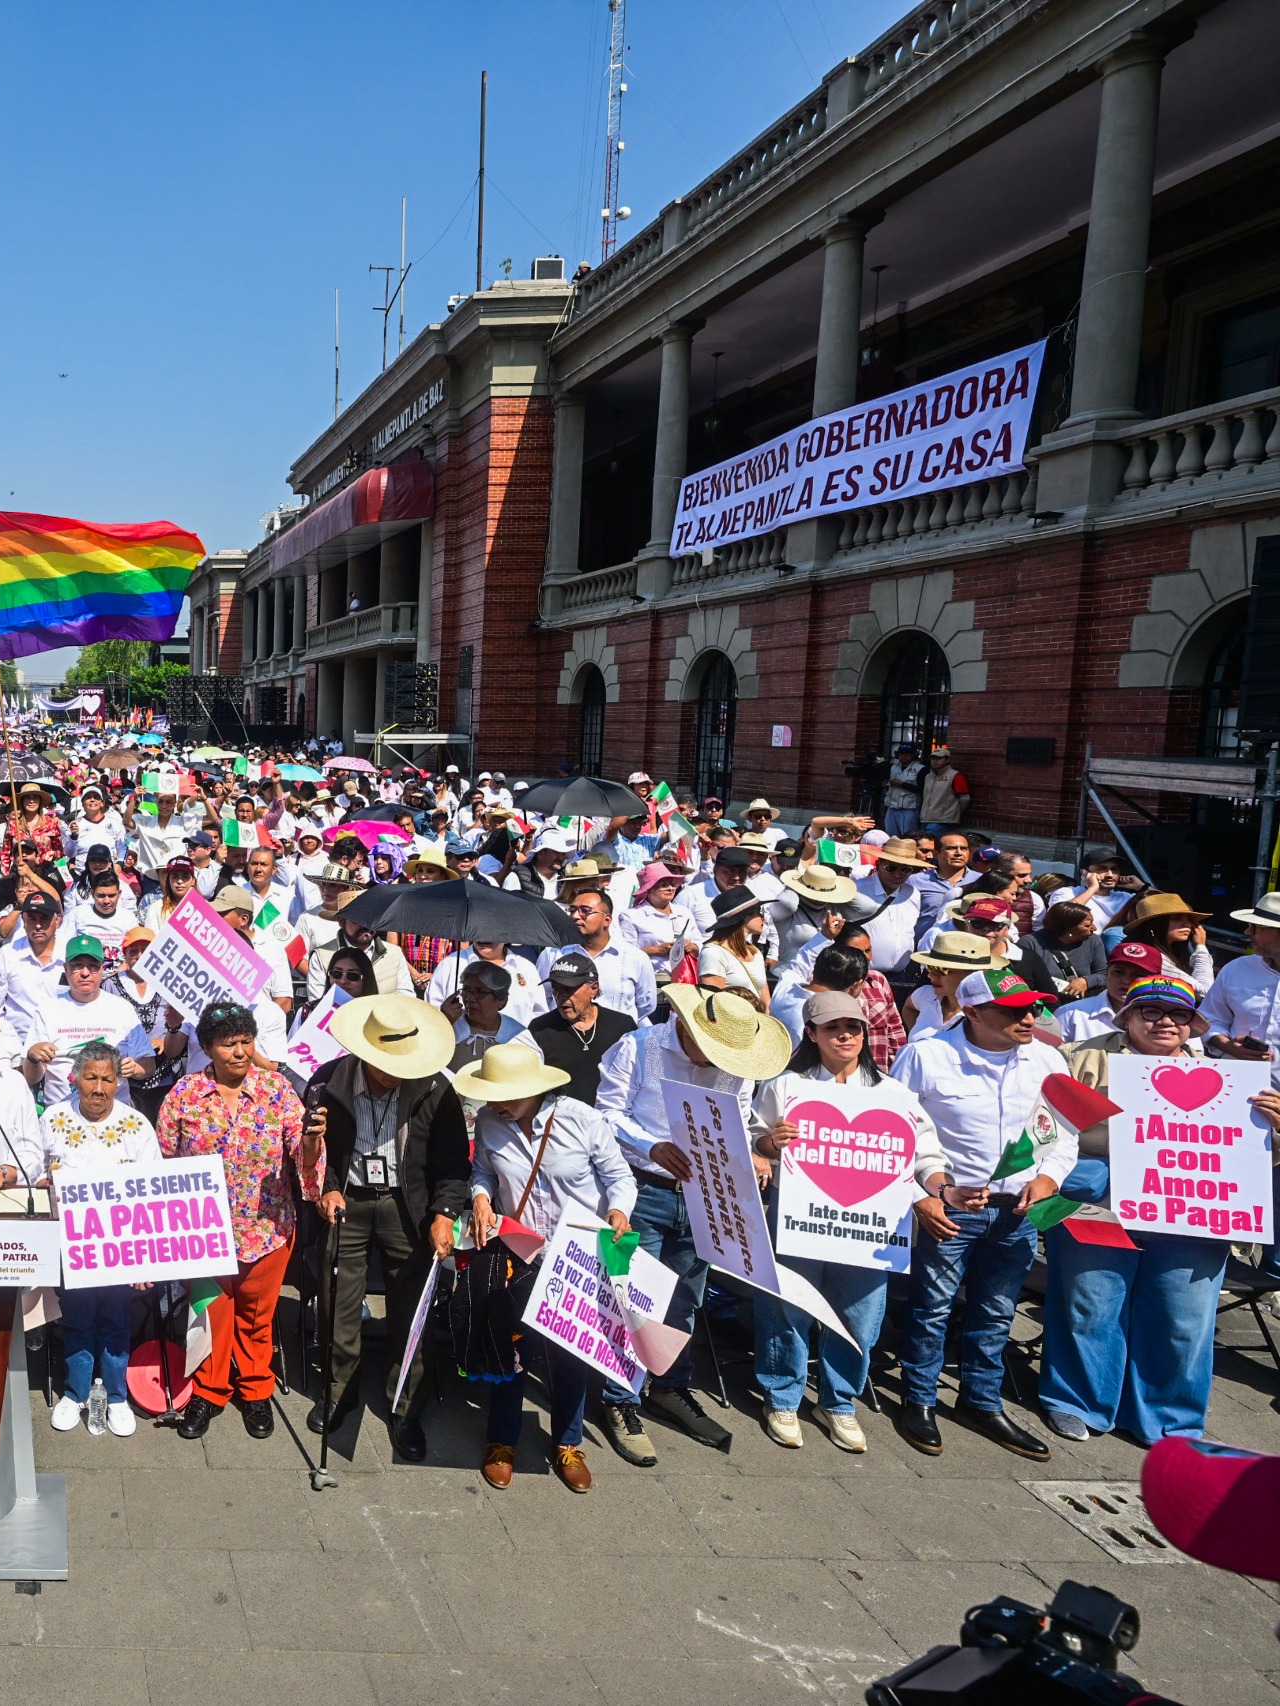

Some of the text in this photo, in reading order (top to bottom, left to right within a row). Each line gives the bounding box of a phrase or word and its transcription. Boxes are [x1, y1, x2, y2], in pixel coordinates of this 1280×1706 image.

[372, 377, 444, 455] TLALNEPANTLA DE BAZ
[682, 357, 1030, 512] BIENVENIDA GOBERNADORA
[675, 421, 1012, 551] TLALNEPANTLA ES SU CASA
[160, 937, 179, 962] EL
[176, 900, 259, 997] PRESIDENTA,
[143, 951, 204, 1017] TE RESPA
[798, 1119, 905, 1153] El corazón
[1134, 1113, 1243, 1146] ¡Amor
[793, 1142, 907, 1176] del EDOMÉX
[1157, 1148, 1221, 1173] con
[61, 1171, 220, 1205] ¡SE VE, SE SIENTE,
[683, 1101, 725, 1257] está presente!
[701, 1124, 735, 1243] el EDOMÉX
[725, 1172, 737, 1199] se
[1142, 1167, 1238, 1201] Amor
[64, 1196, 224, 1242] LA PATRIA
[784, 1215, 909, 1248] Transformación
[808, 1202, 887, 1228] late con la
[1119, 1197, 1264, 1236] se Paga!
[3, 1253, 39, 1262] PATRIA
[68, 1231, 229, 1271] SE DEFIENDE!
[565, 1239, 602, 1277] Claudia
[730, 1201, 754, 1277] siente,
[552, 1254, 611, 1307] la voz de las
[561, 1288, 571, 1313] la
[575, 1296, 615, 1337] fuerza
[535, 1300, 578, 1344] Estado
[576, 1328, 596, 1355] de
[593, 1340, 636, 1383] México
